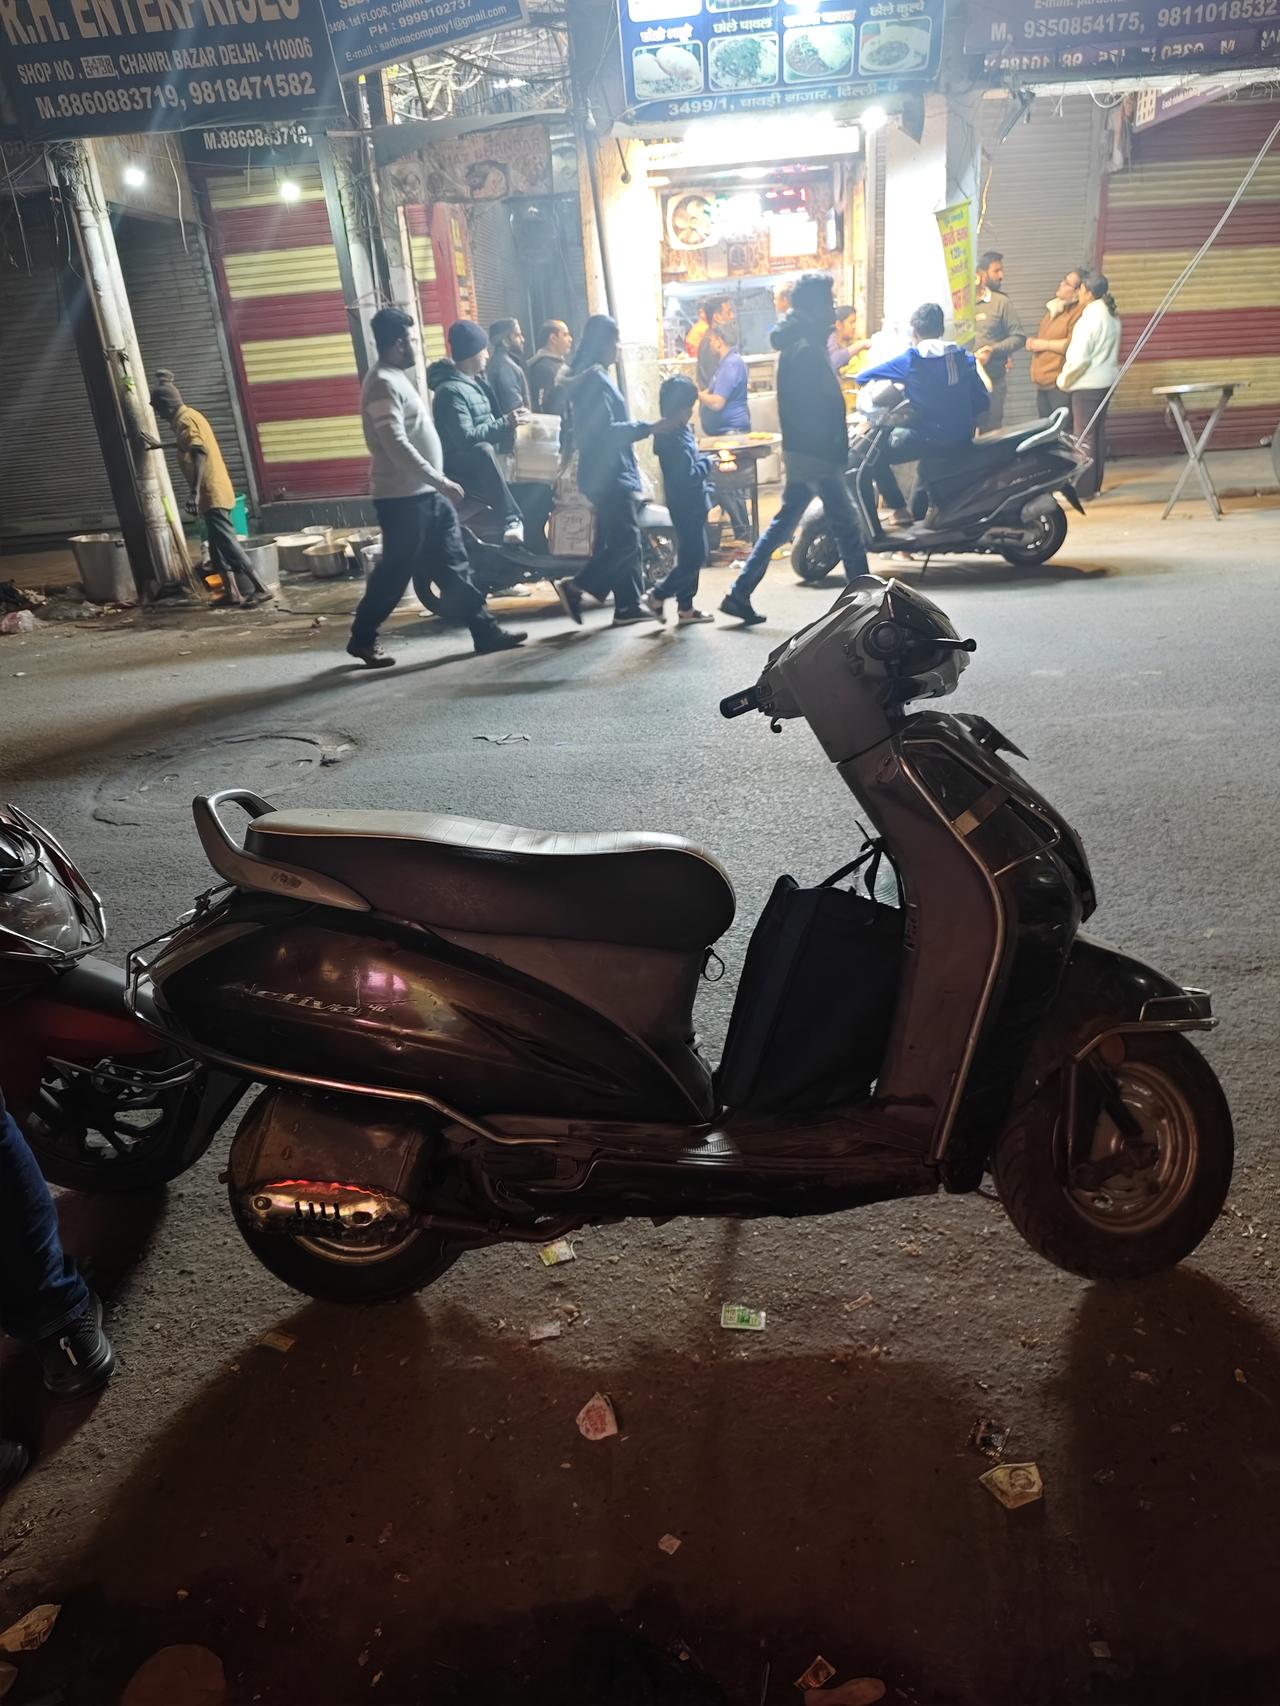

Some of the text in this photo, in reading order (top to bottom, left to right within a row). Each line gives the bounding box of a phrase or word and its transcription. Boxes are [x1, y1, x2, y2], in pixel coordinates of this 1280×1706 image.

[17, 61, 53, 85] SHOP
[118, 50, 172, 76] CHAWRI
[174, 45, 219, 71] BAZAR
[265, 37, 313, 62] 110006
[34, 71, 316, 120] M.8860883719, 9818471582
[668, 97, 735, 116] 3499/1,
